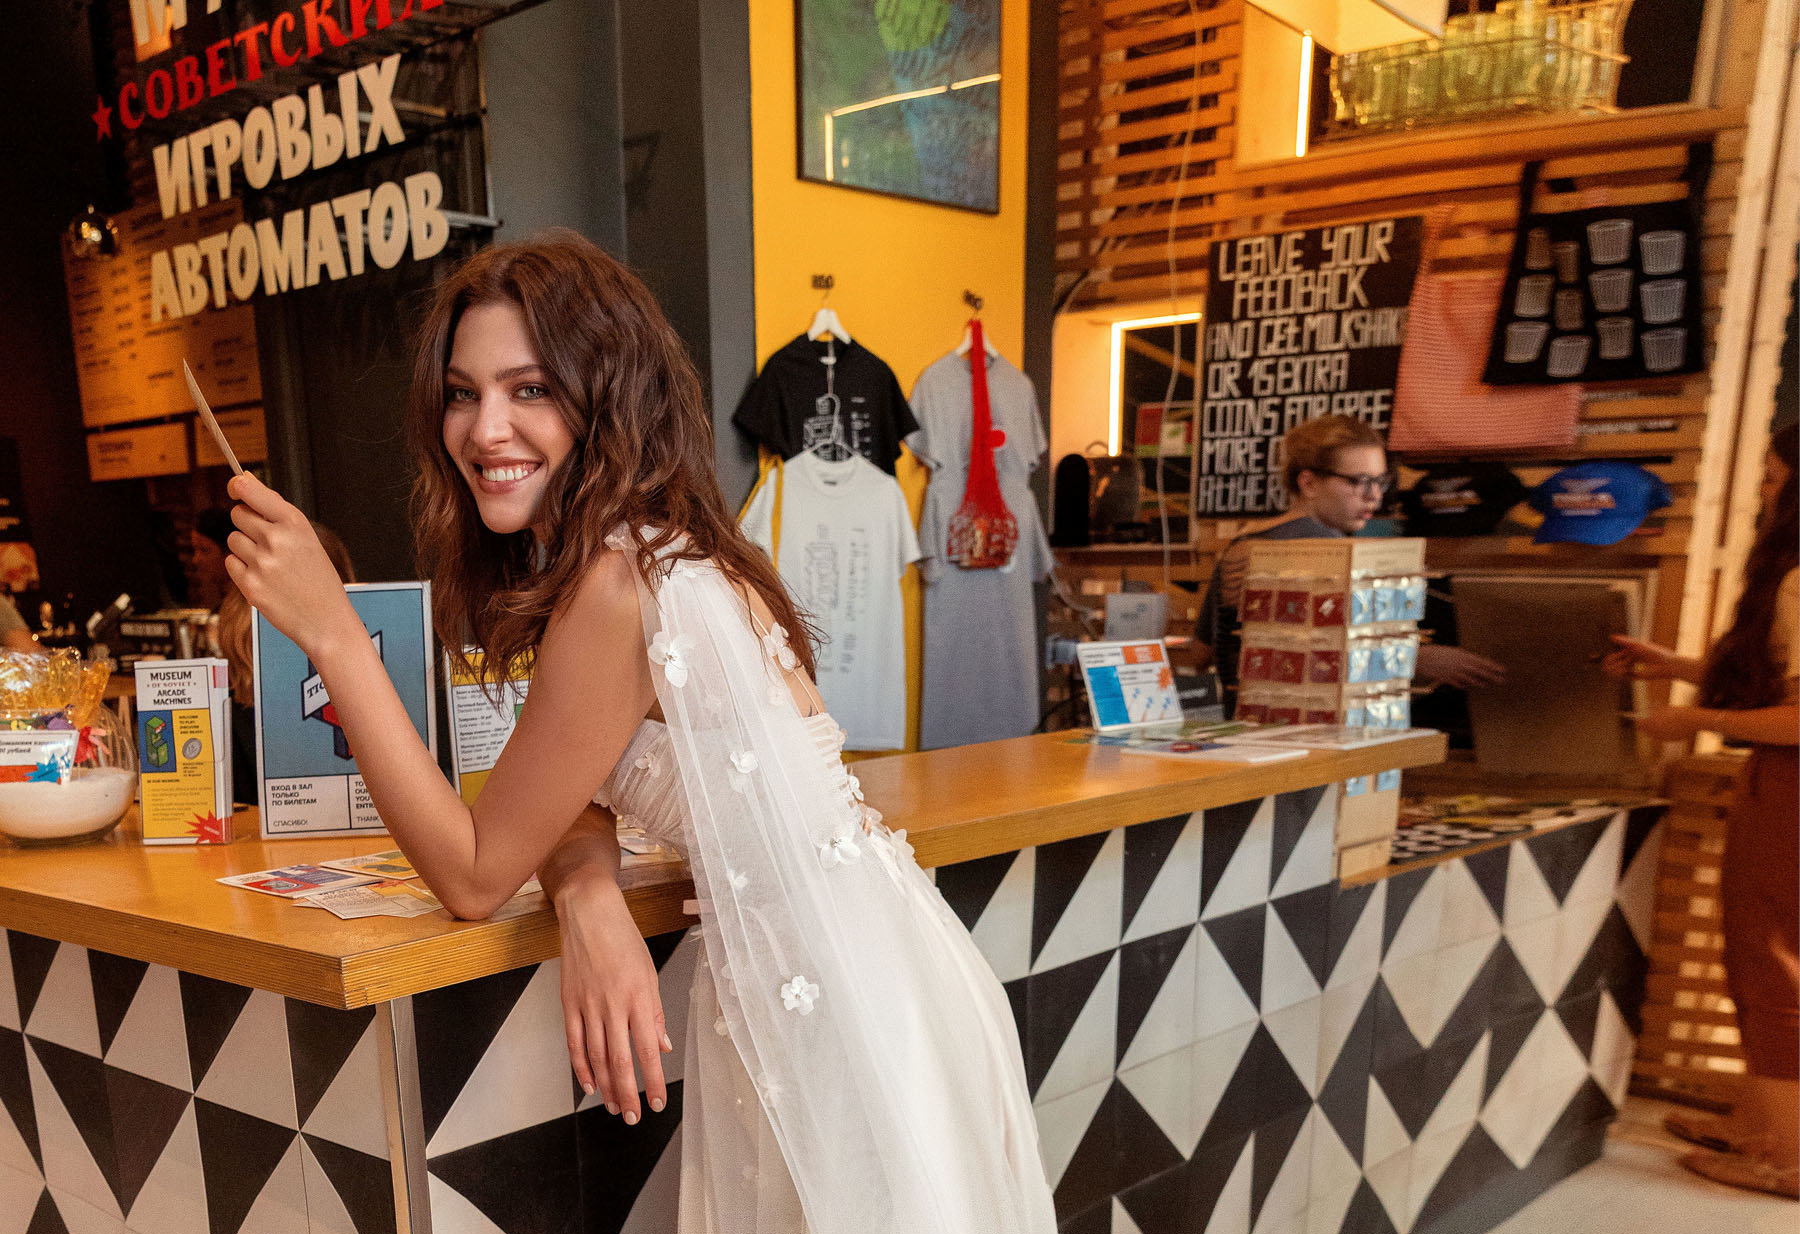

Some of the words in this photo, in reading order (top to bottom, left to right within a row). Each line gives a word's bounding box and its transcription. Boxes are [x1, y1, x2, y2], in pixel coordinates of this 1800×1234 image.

[118, 0, 444, 130] СОВЕТСКИ
[152, 53, 406, 219] ИГРОВЫХ
[151, 171, 450, 323] АВТОМАТОВ
[1219, 231, 1307, 282] LEAVE
[1320, 220, 1396, 270] YOUR
[1232, 265, 1370, 320] FEEDBACK
[1205, 320, 1256, 362] AND
[1207, 361, 1243, 400] OR
[1276, 351, 1350, 394] EXTRA
[1202, 396, 1283, 438] COINS
[1201, 435, 1266, 476] MORE
[150, 671, 192, 681] MUSEUM
[157, 689, 186, 697] ARCADE
[153, 698, 192, 706] MACHINES
[273, 819, 308, 827] СПАСИБО!
[284, 798, 317, 806] БИЛЕТАМ
